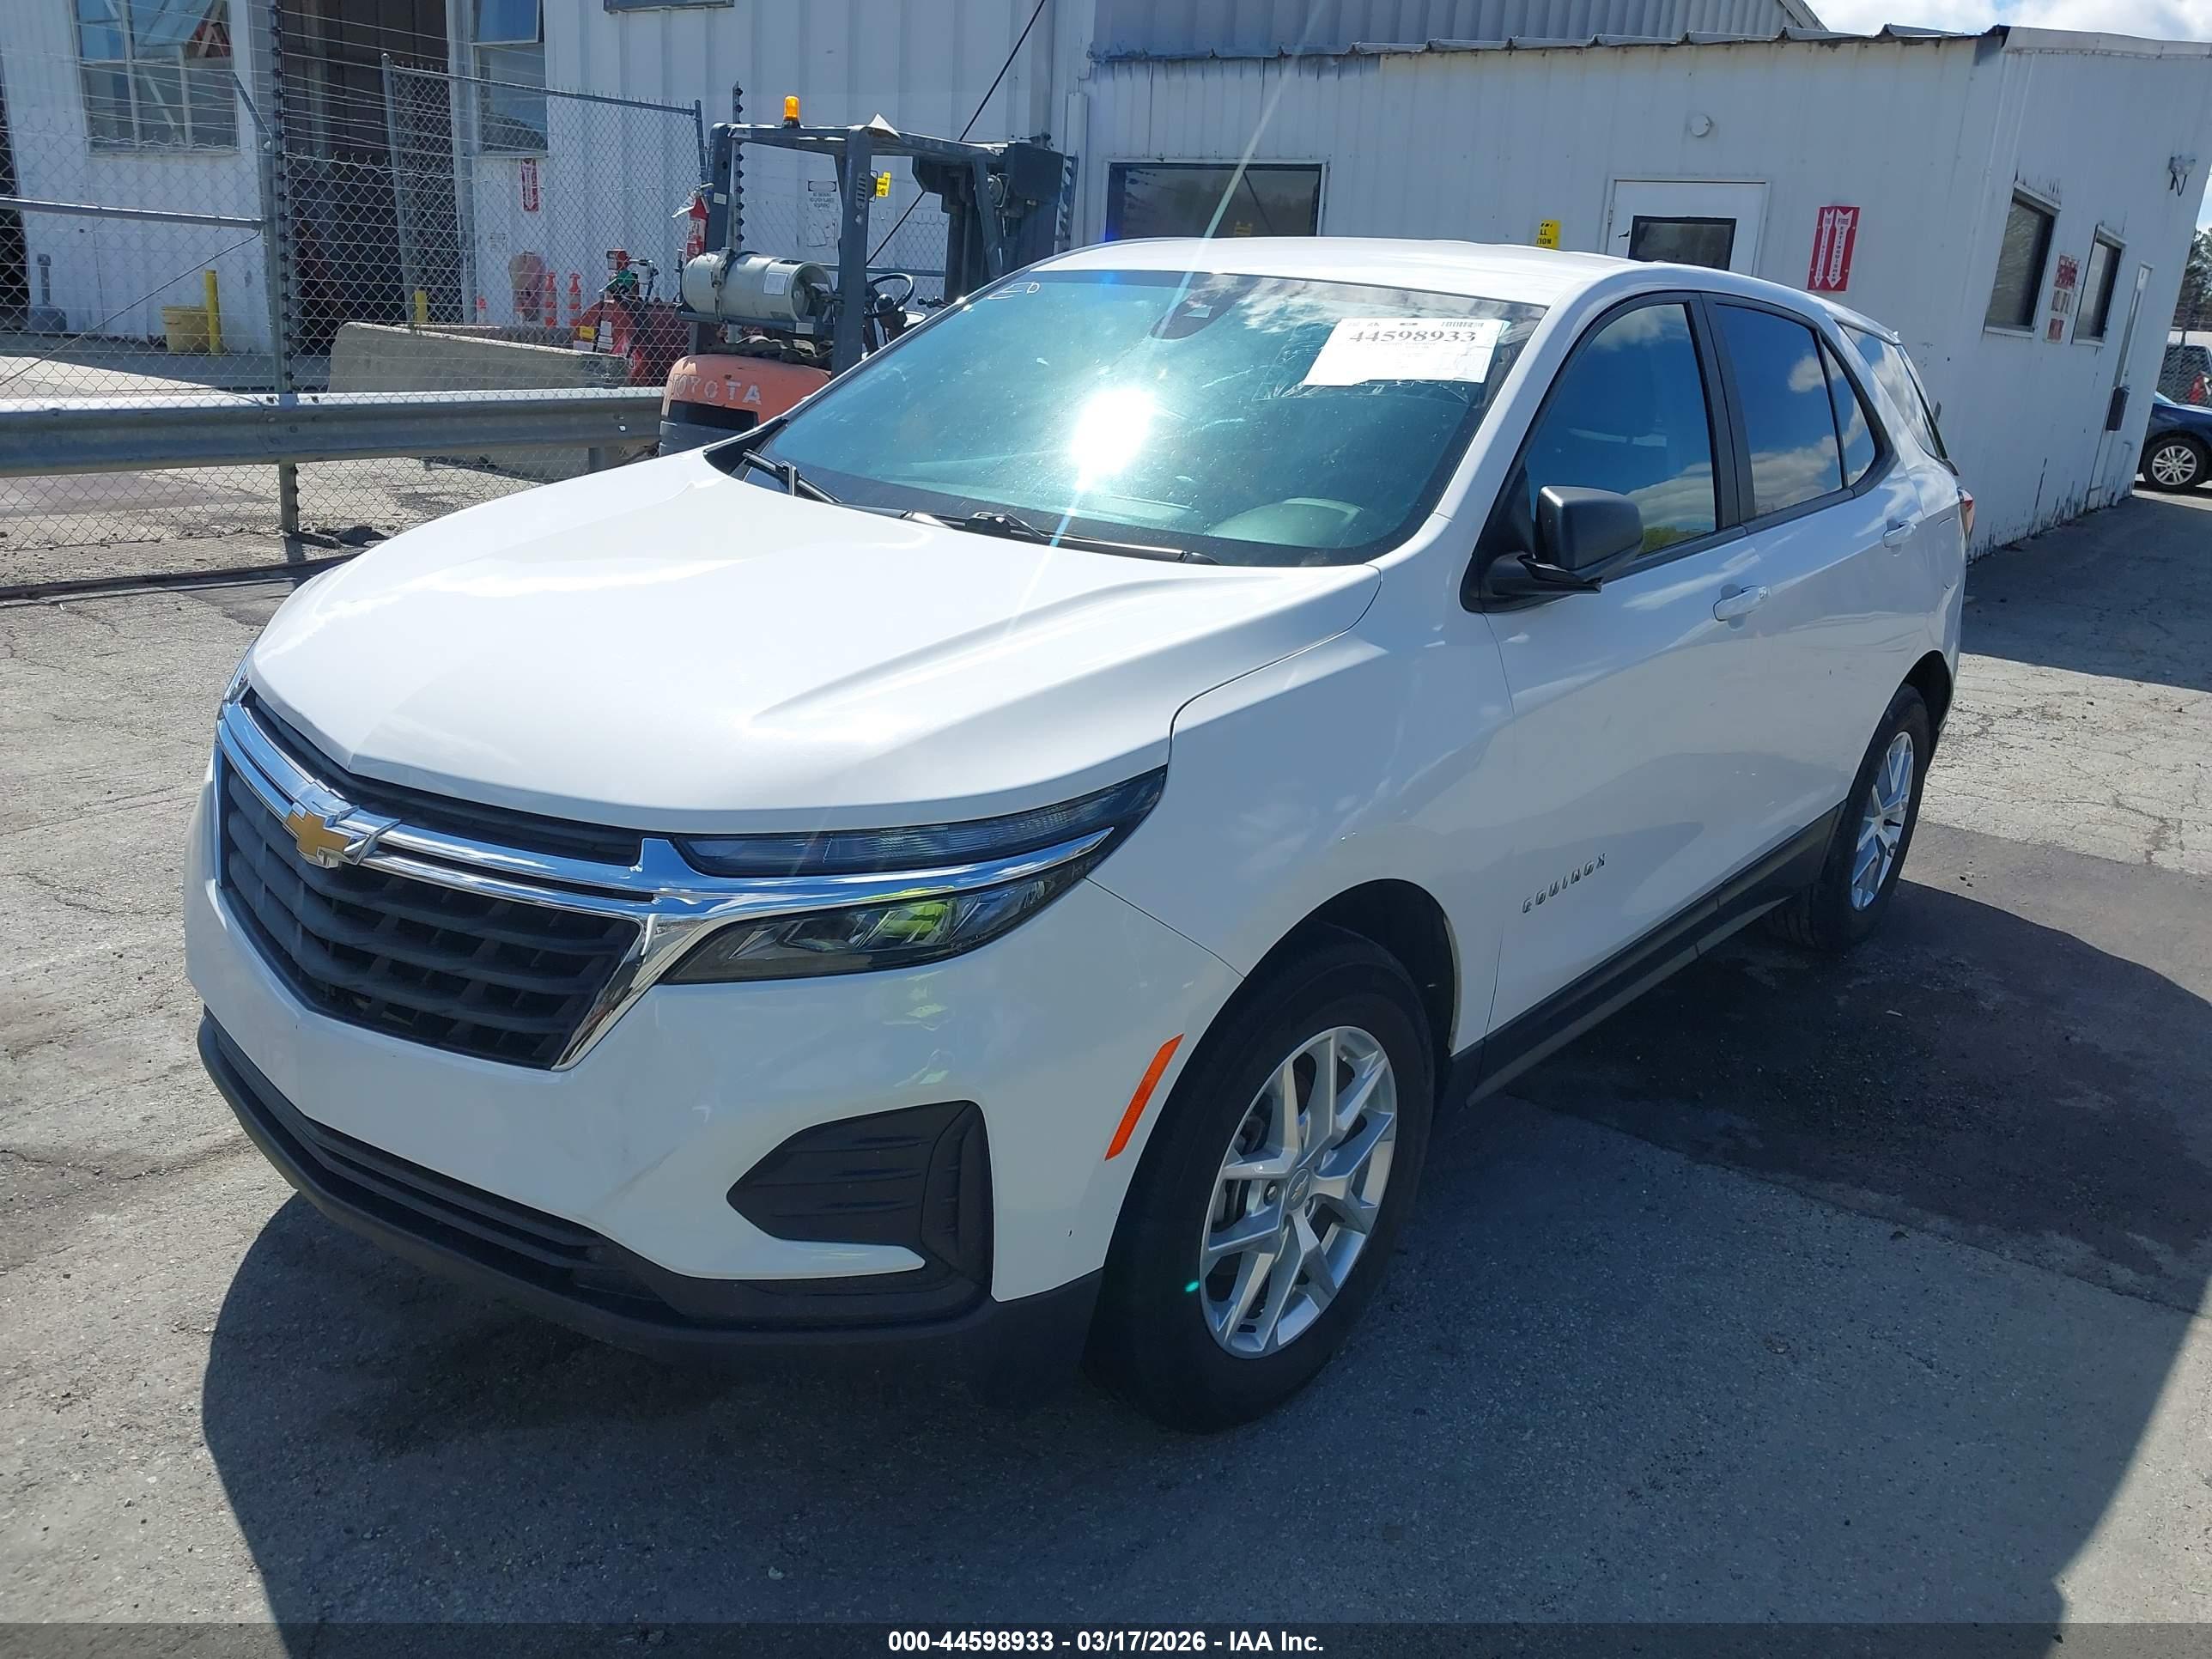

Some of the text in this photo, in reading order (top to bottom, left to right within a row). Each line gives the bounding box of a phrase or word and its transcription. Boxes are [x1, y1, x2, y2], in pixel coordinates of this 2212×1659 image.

[1349, 330, 1477, 343] 44598933
[672, 374, 762, 405] TOYOTA
[1522, 852, 1605, 914] EQUINOX
